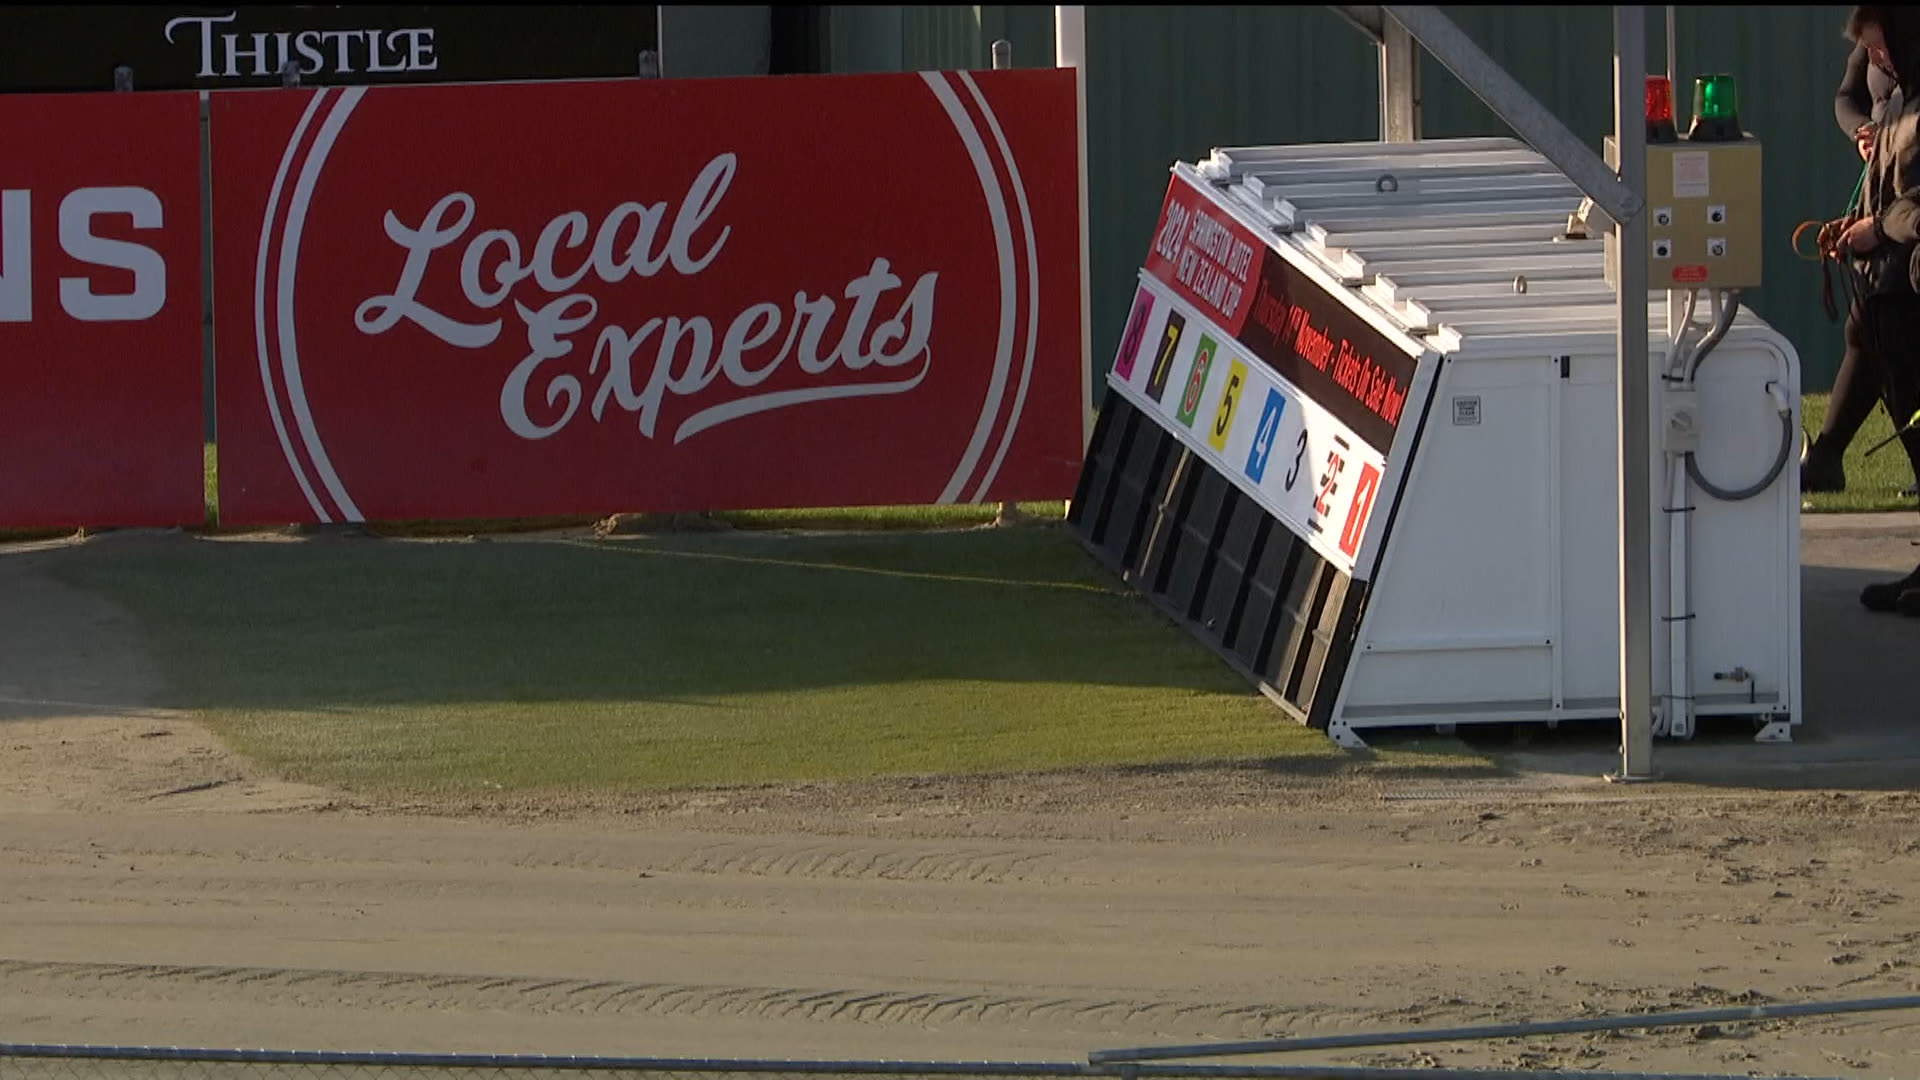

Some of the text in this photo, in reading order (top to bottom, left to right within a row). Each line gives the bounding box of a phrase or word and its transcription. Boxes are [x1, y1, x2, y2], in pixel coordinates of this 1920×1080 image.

[164, 10, 438, 77] THISTLE
[354, 152, 737, 348] Local
[1156, 198, 1191, 264] 2024
[1226, 237, 1254, 283] HOTEL
[1177, 245, 1242, 319] NEW ZEALAND CUP
[500, 257, 938, 442] Experts
[1293, 311, 1335, 373] November
[1332, 339, 1361, 393] Tickets
[1356, 356, 1372, 402] On
[1365, 364, 1386, 412] Sale
[1379, 376, 1407, 427] Now!
[1123, 303, 1372, 546] 8 7 6 5 4 3 2 1
